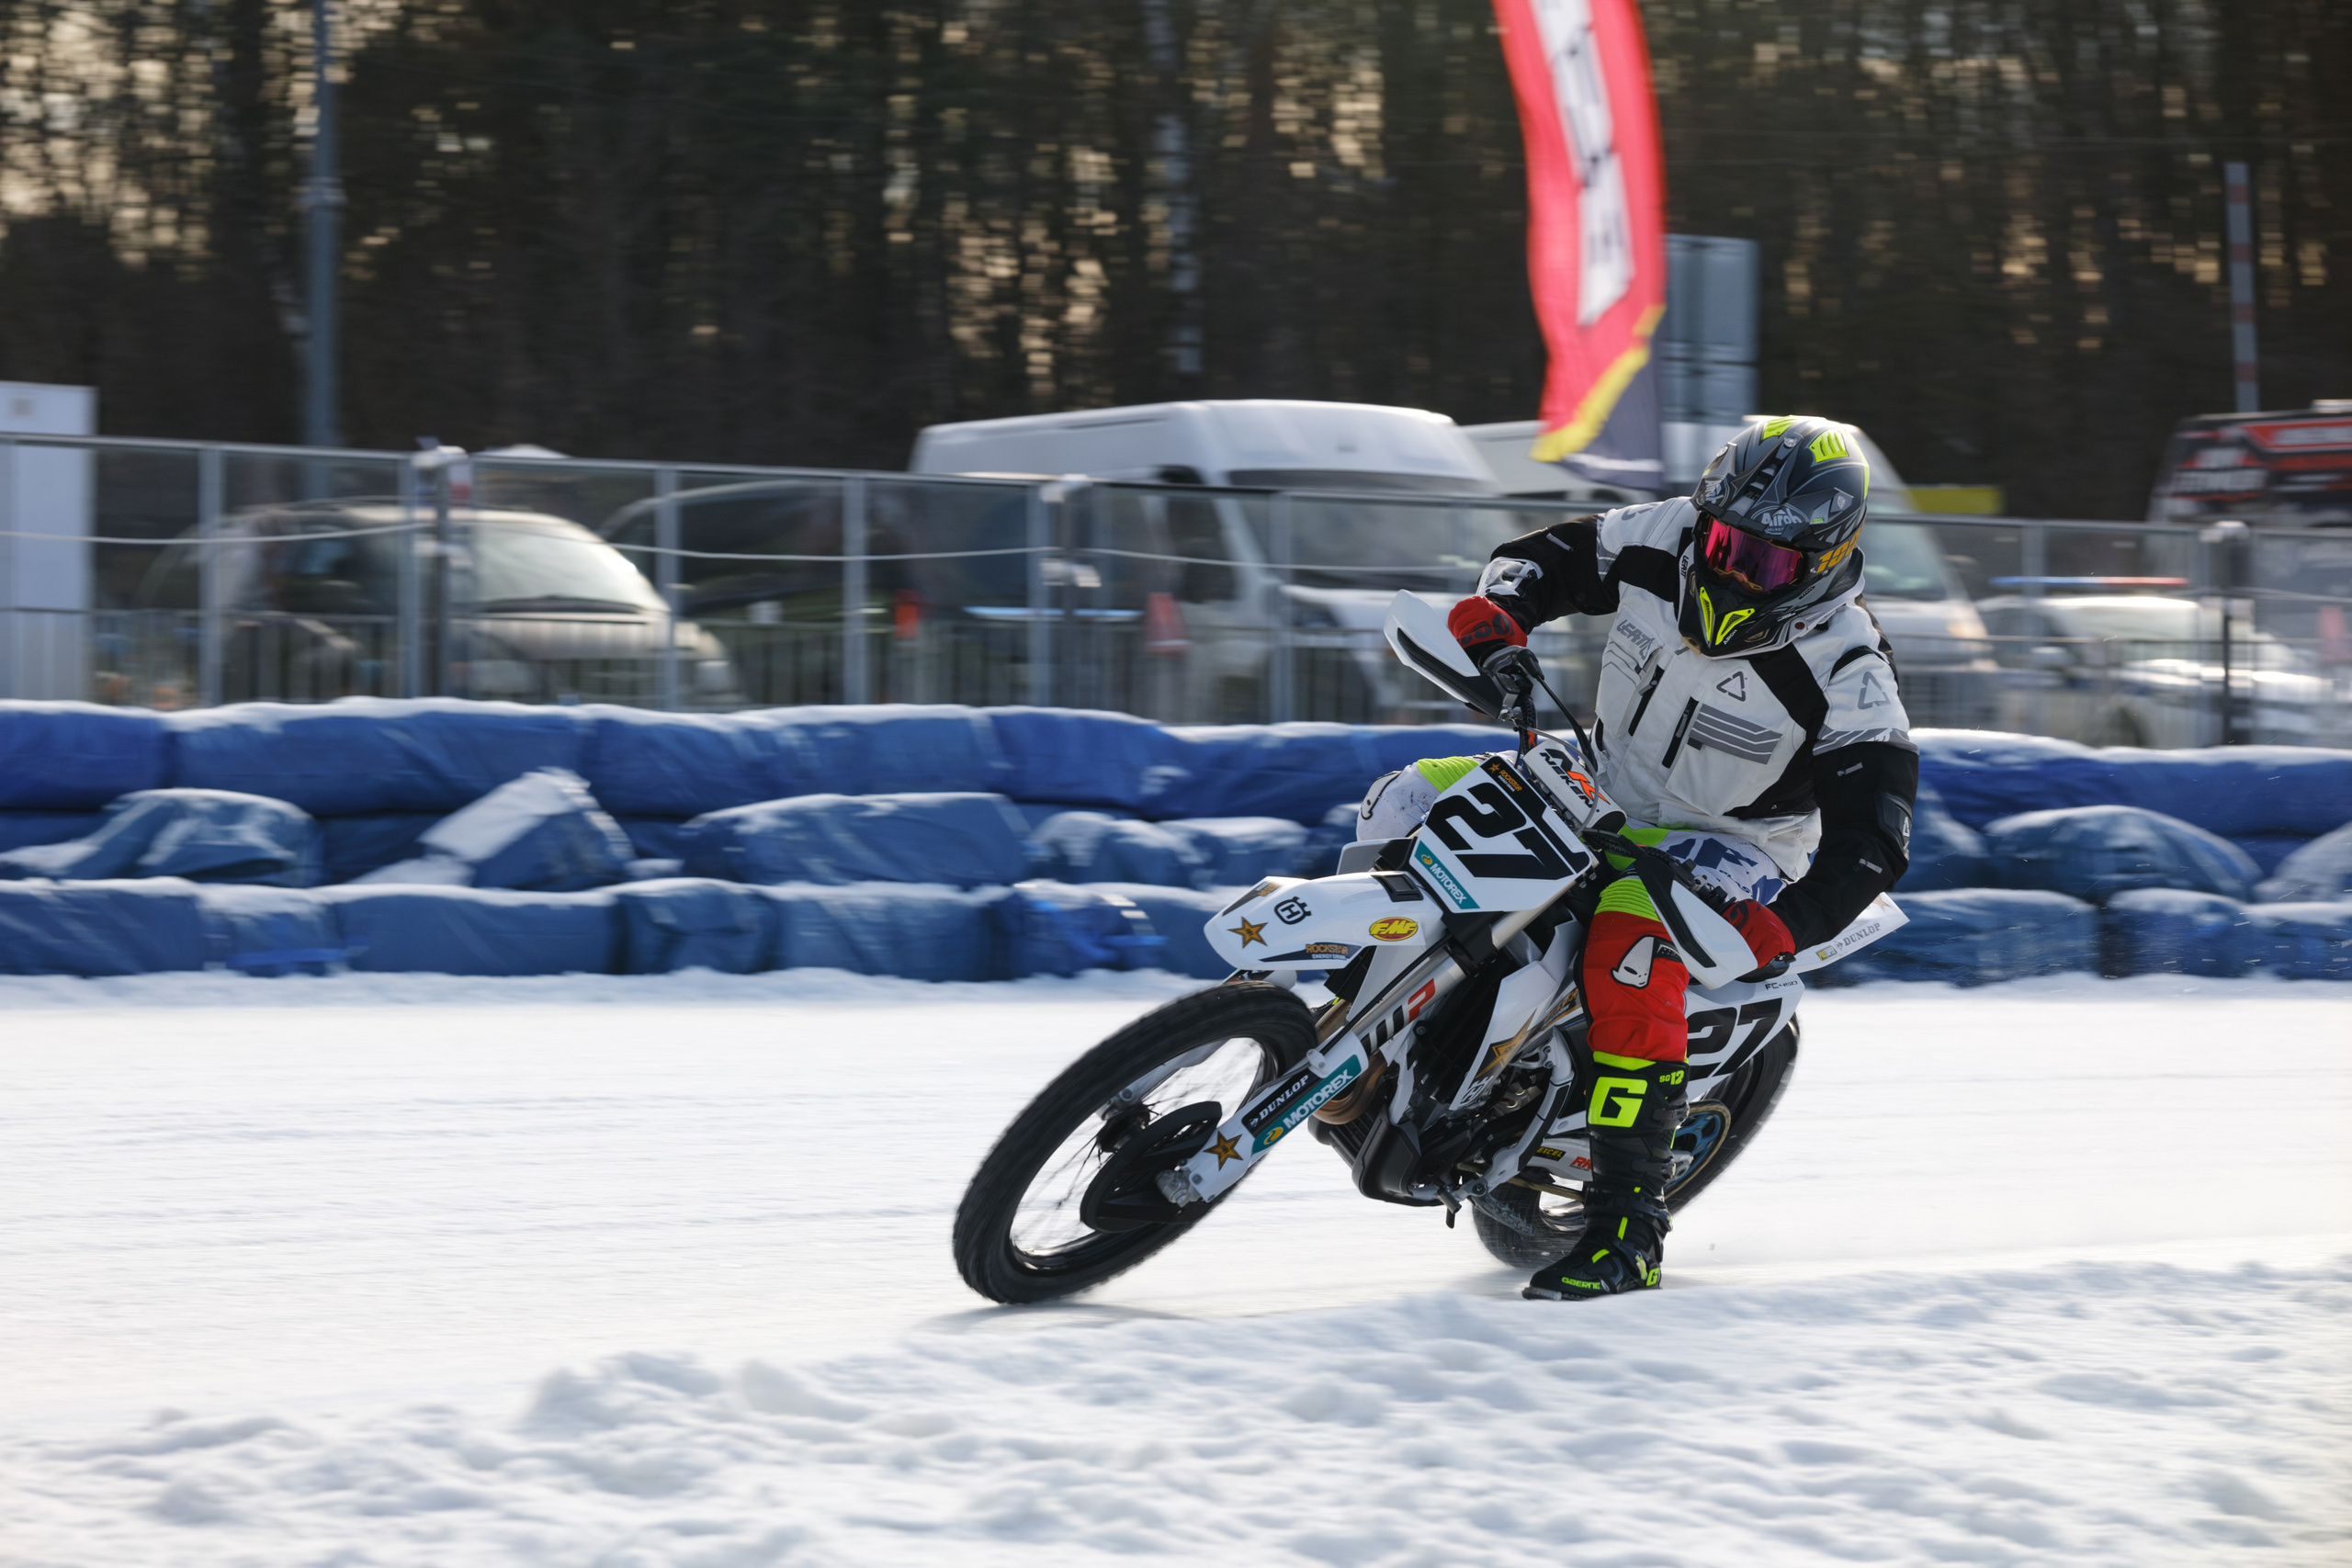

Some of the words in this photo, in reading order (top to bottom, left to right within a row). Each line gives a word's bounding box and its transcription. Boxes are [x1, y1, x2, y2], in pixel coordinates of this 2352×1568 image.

[1761, 508, 1804, 528] Airoh
[1680, 554, 1690, 581] LEATT
[1816, 519, 1865, 574] 100
[1498, 770, 1522, 792] ROCKSTAR
[1538, 752, 1594, 808] NEKEN
[1425, 782, 1575, 881] 27
[1430, 863, 1467, 905] MOTOREX
[1369, 919, 1418, 936] FMF
[1843, 922, 1882, 947] DUNLOP
[1306, 943, 1349, 955] ROCKSTAR
[1687, 997, 1783, 1082] 27
[1258, 1074, 1309, 1122] DUNLOP
[1282, 1068, 1353, 1129] MOTOREX
[1588, 1077, 1648, 1128] G
[1536, 1146, 1564, 1157] EXCEL
